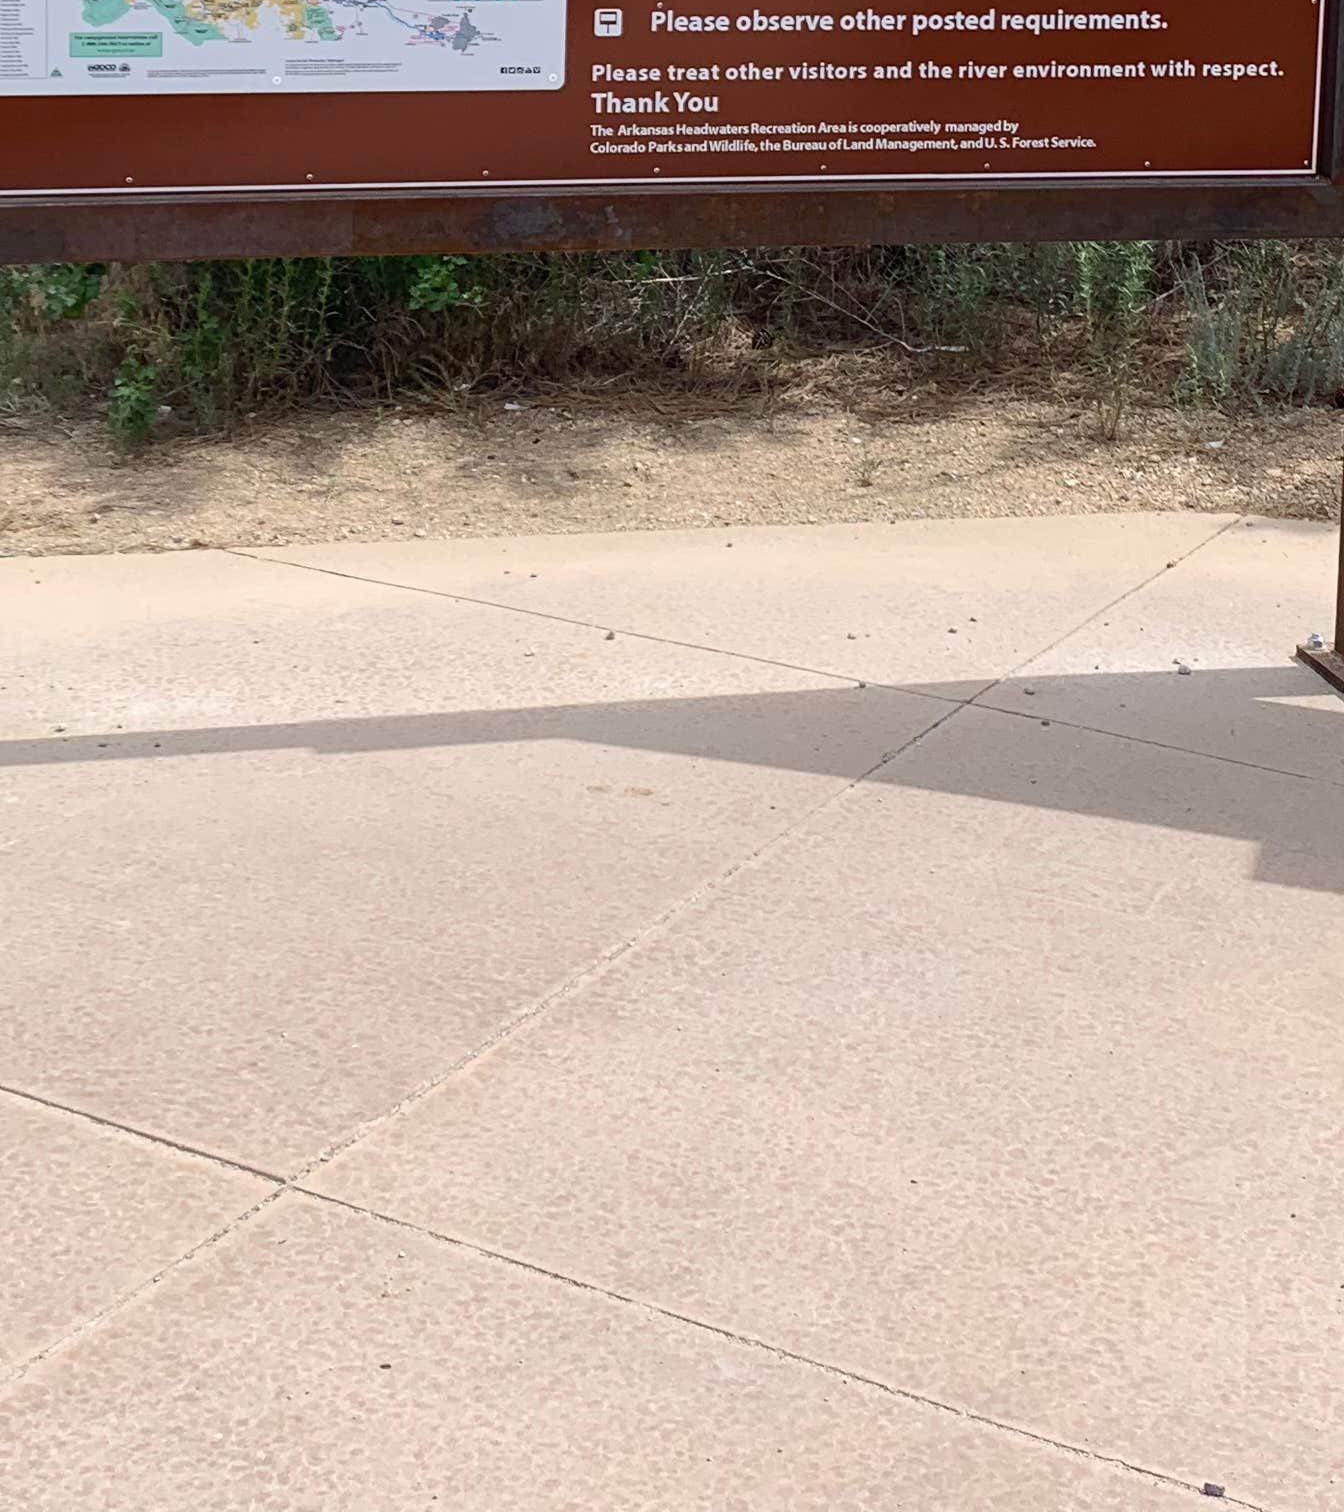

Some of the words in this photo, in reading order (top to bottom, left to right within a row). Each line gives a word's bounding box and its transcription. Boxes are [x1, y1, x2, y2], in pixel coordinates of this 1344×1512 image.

[651, 10, 730, 32] Please
[736, 9, 834, 31] observe
[840, 9, 907, 30] other
[913, 8, 995, 35] posted
[1002, 9, 1168, 35] requirements.
[592, 64, 661, 82] Please
[667, 65, 720, 81] treat
[725, 62, 784, 80] other
[789, 62, 867, 79] visitors
[873, 61, 912, 79] and
[918, 61, 953, 78] the
[959, 61, 1007, 78] river
[1013, 60, 1145, 78] environment
[1150, 60, 1195, 77] with
[1203, 61, 1284, 80] respect.
[591, 91, 670, 113] Thank
[673, 92, 718, 112] You
[590, 124, 614, 136] The
[617, 123, 674, 136] Arkansas
[676, 123, 749, 135] Headwaters
[751, 122, 816, 134] Recreation
[818, 122, 847, 133] Area
[848, 121, 858, 133] is
[860, 120, 941, 135] cooperatively
[945, 120, 1002, 135] managed
[1003, 120, 1019, 134] by
